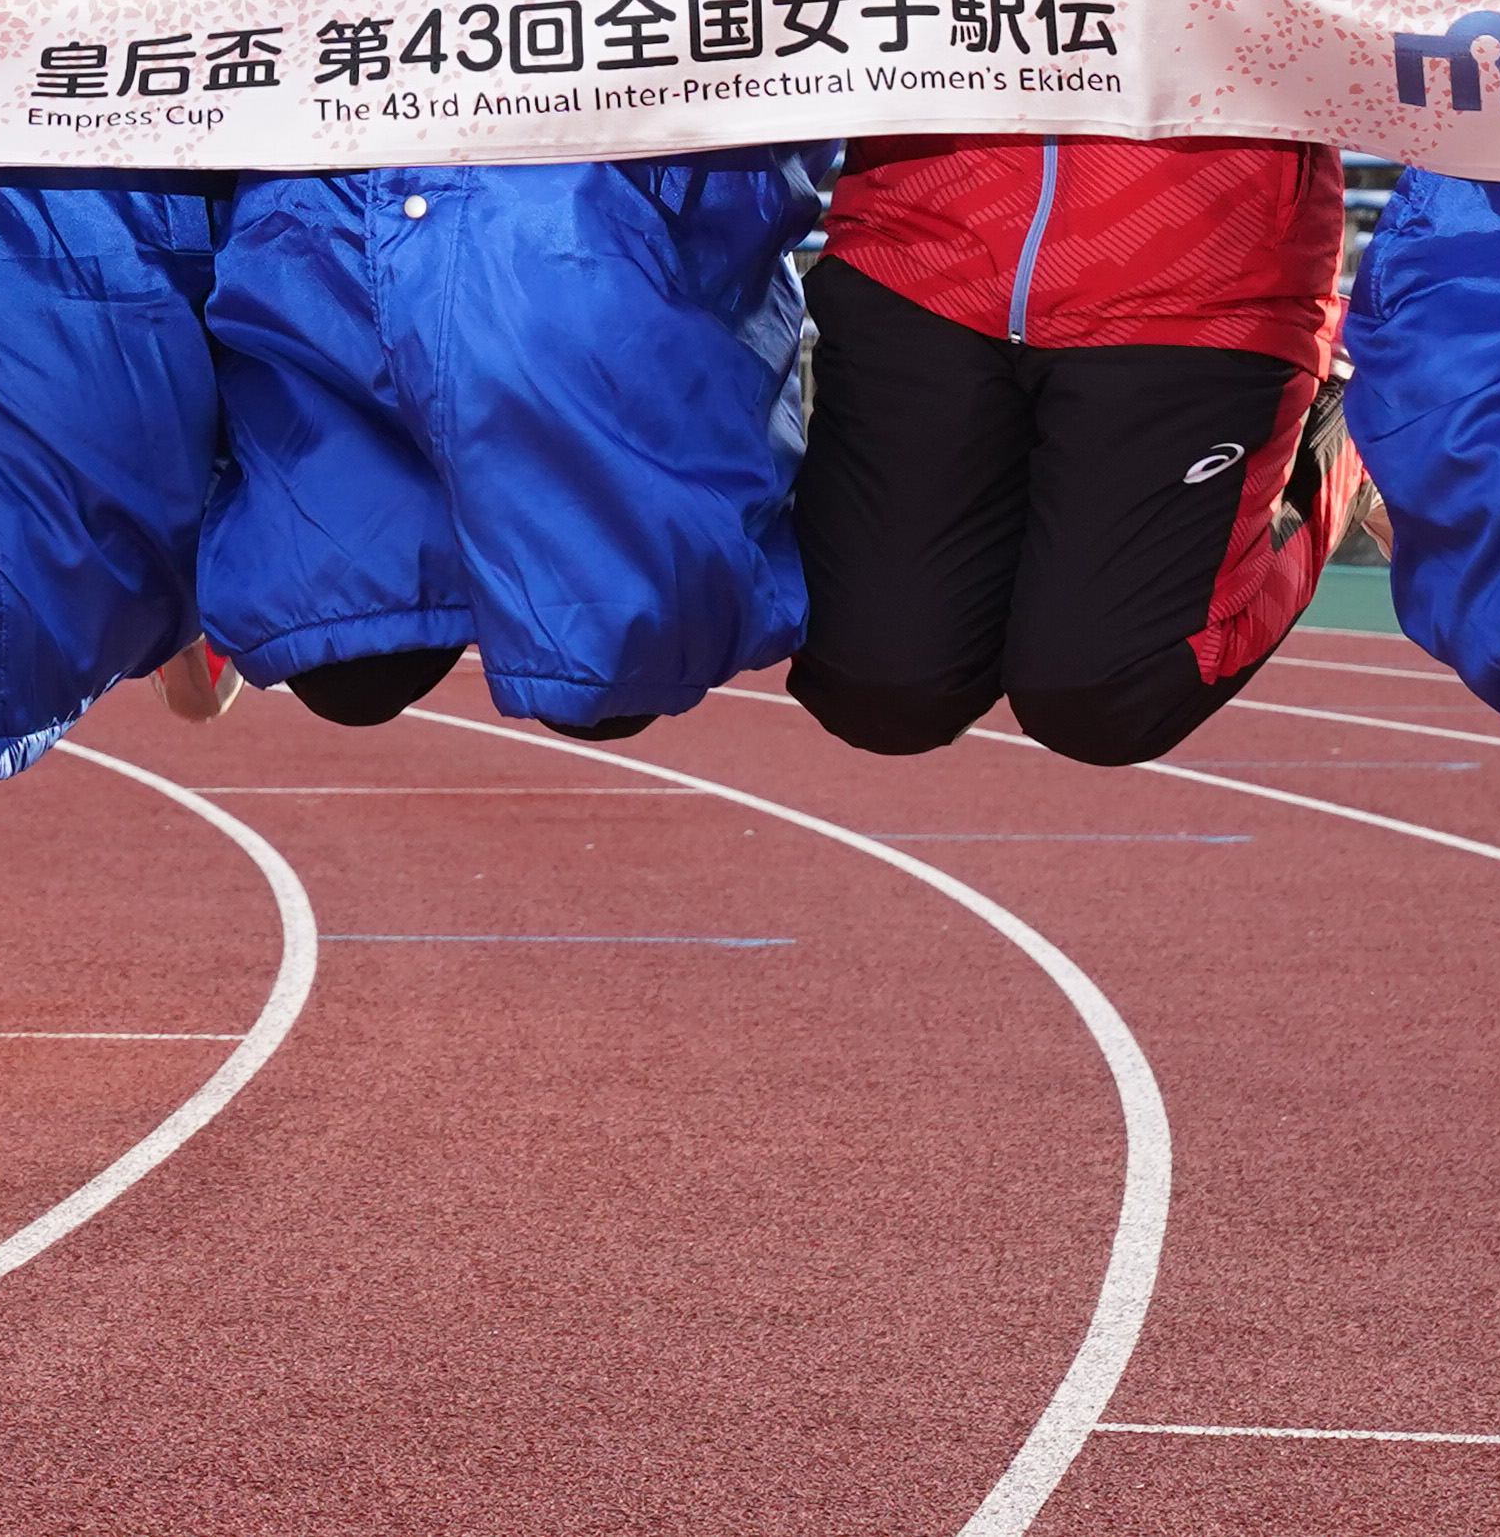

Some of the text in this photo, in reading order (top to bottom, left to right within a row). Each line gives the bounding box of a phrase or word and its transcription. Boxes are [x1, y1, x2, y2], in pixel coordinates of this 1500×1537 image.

[30, 26, 284, 98] 皇后盃
[166, 105, 224, 130] Cup
[314, 97, 371, 122] The
[473, 87, 582, 116] Annual
[595, 65, 855, 111] Inter-Prefectural
[865, 65, 1008, 92] Women's
[1019, 66, 1122, 94] Ekiden
